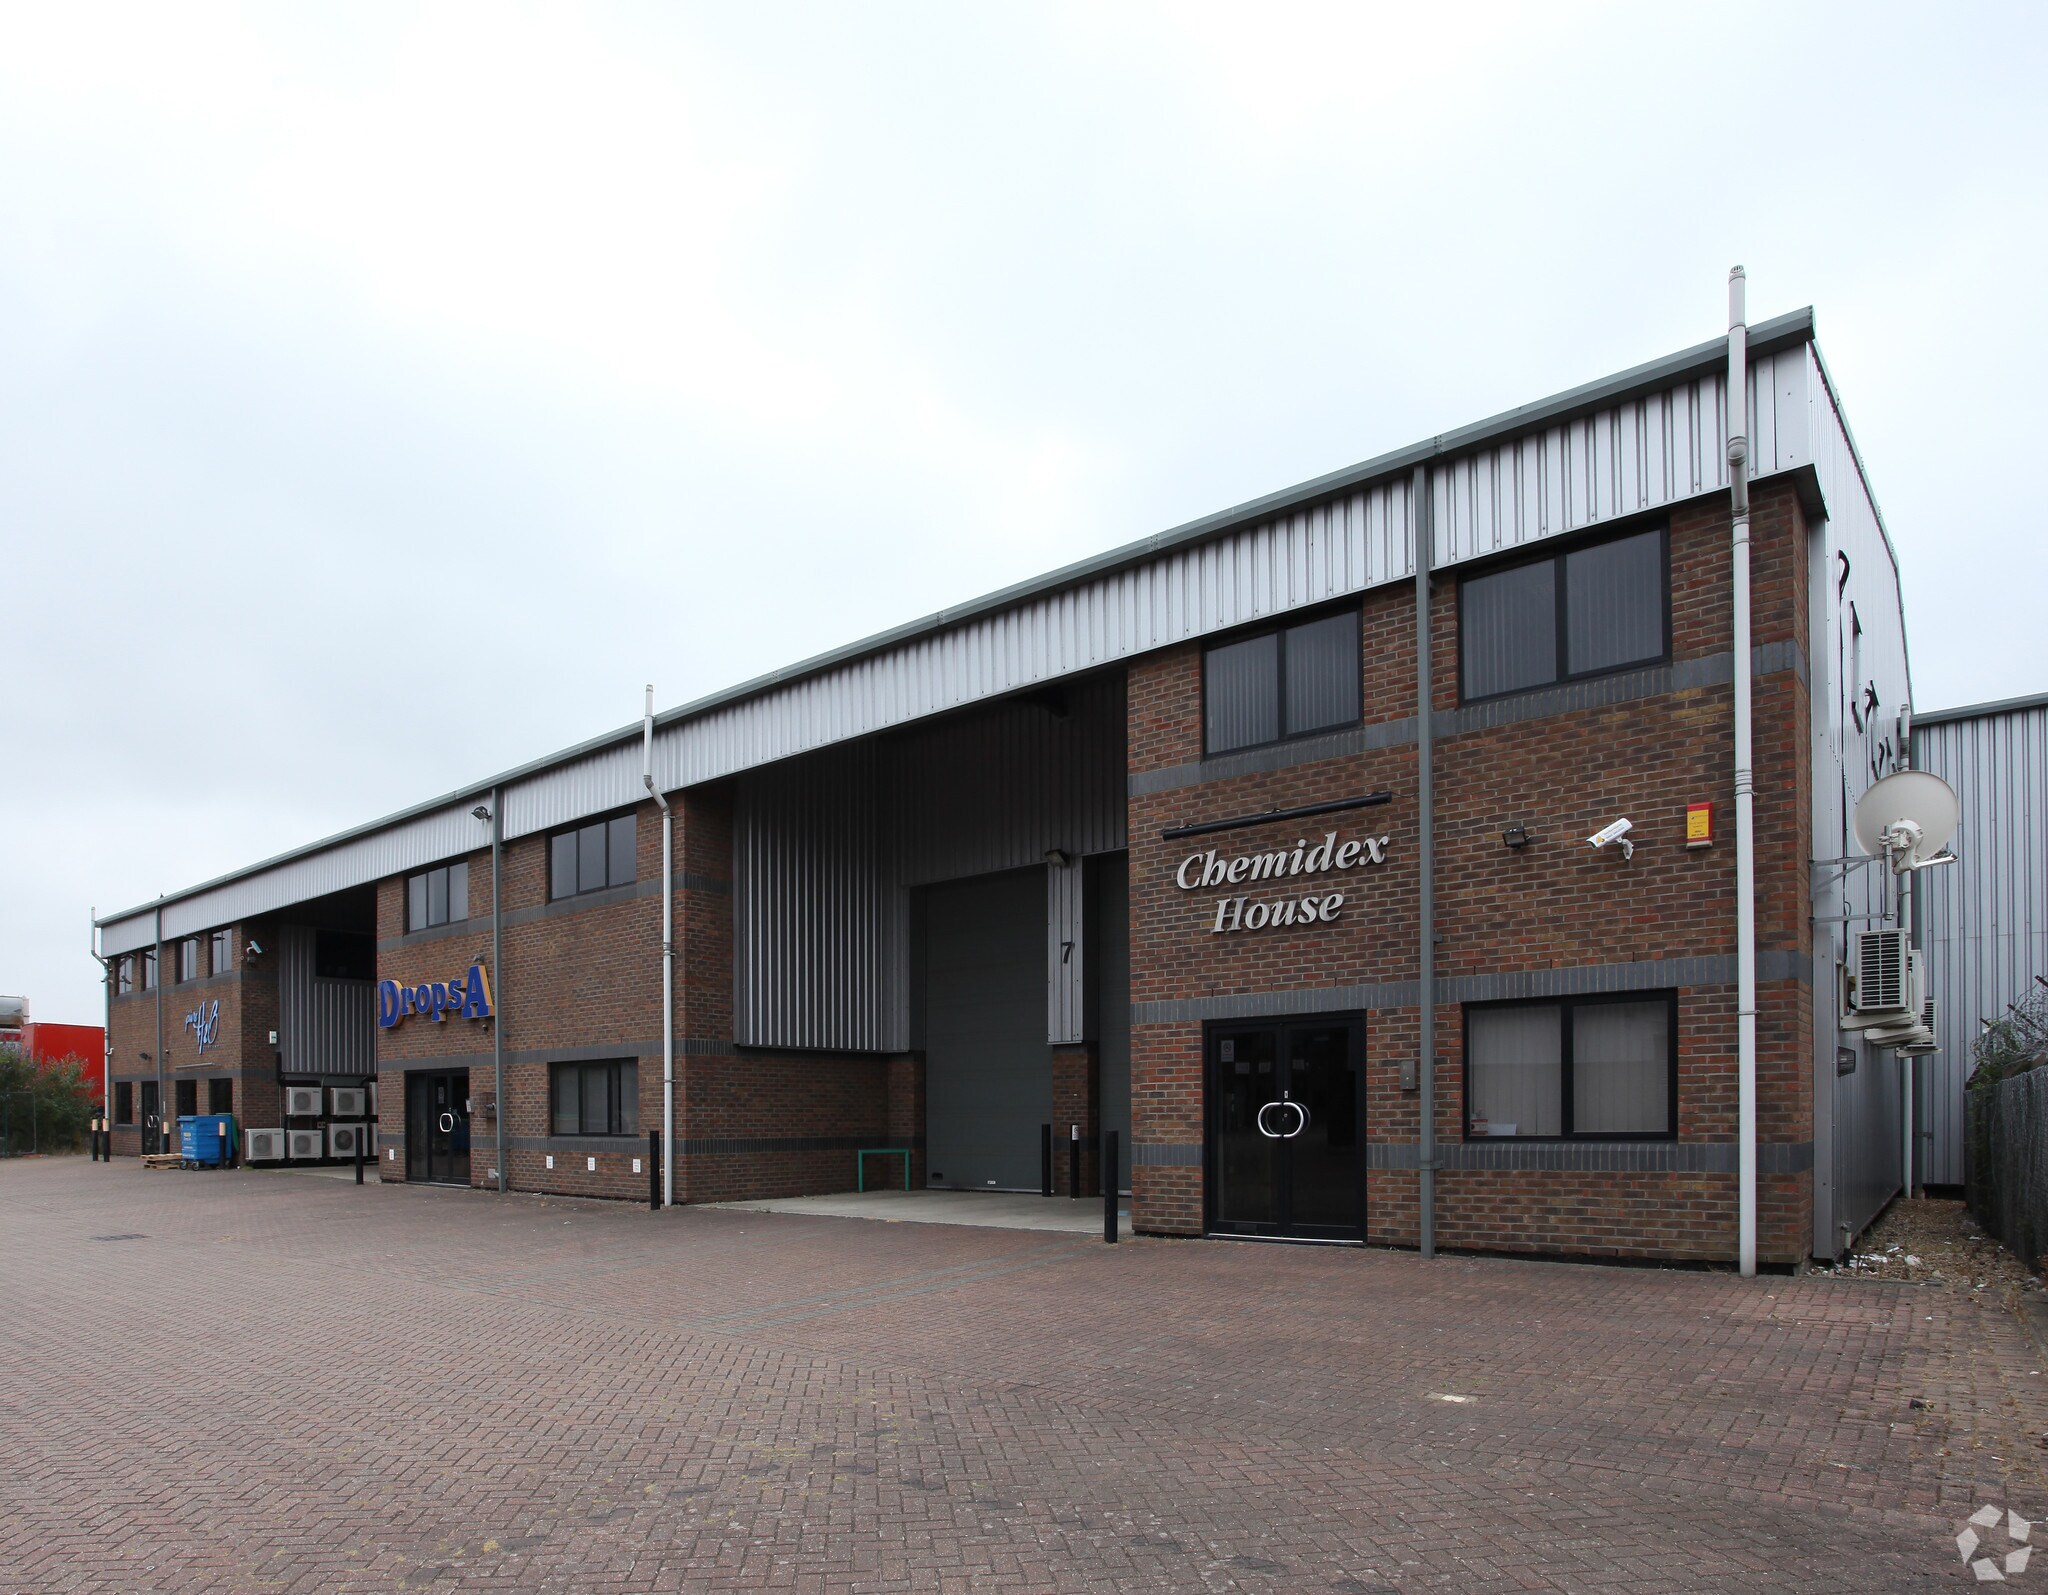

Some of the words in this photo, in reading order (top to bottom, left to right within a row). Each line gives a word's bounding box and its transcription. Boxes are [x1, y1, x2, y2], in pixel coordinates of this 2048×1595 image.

[1176, 831, 1389, 890] Chemidex
[1212, 893, 1344, 934] House
[1061, 941, 1075, 964] 7
[379, 965, 494, 1029] DropsA
